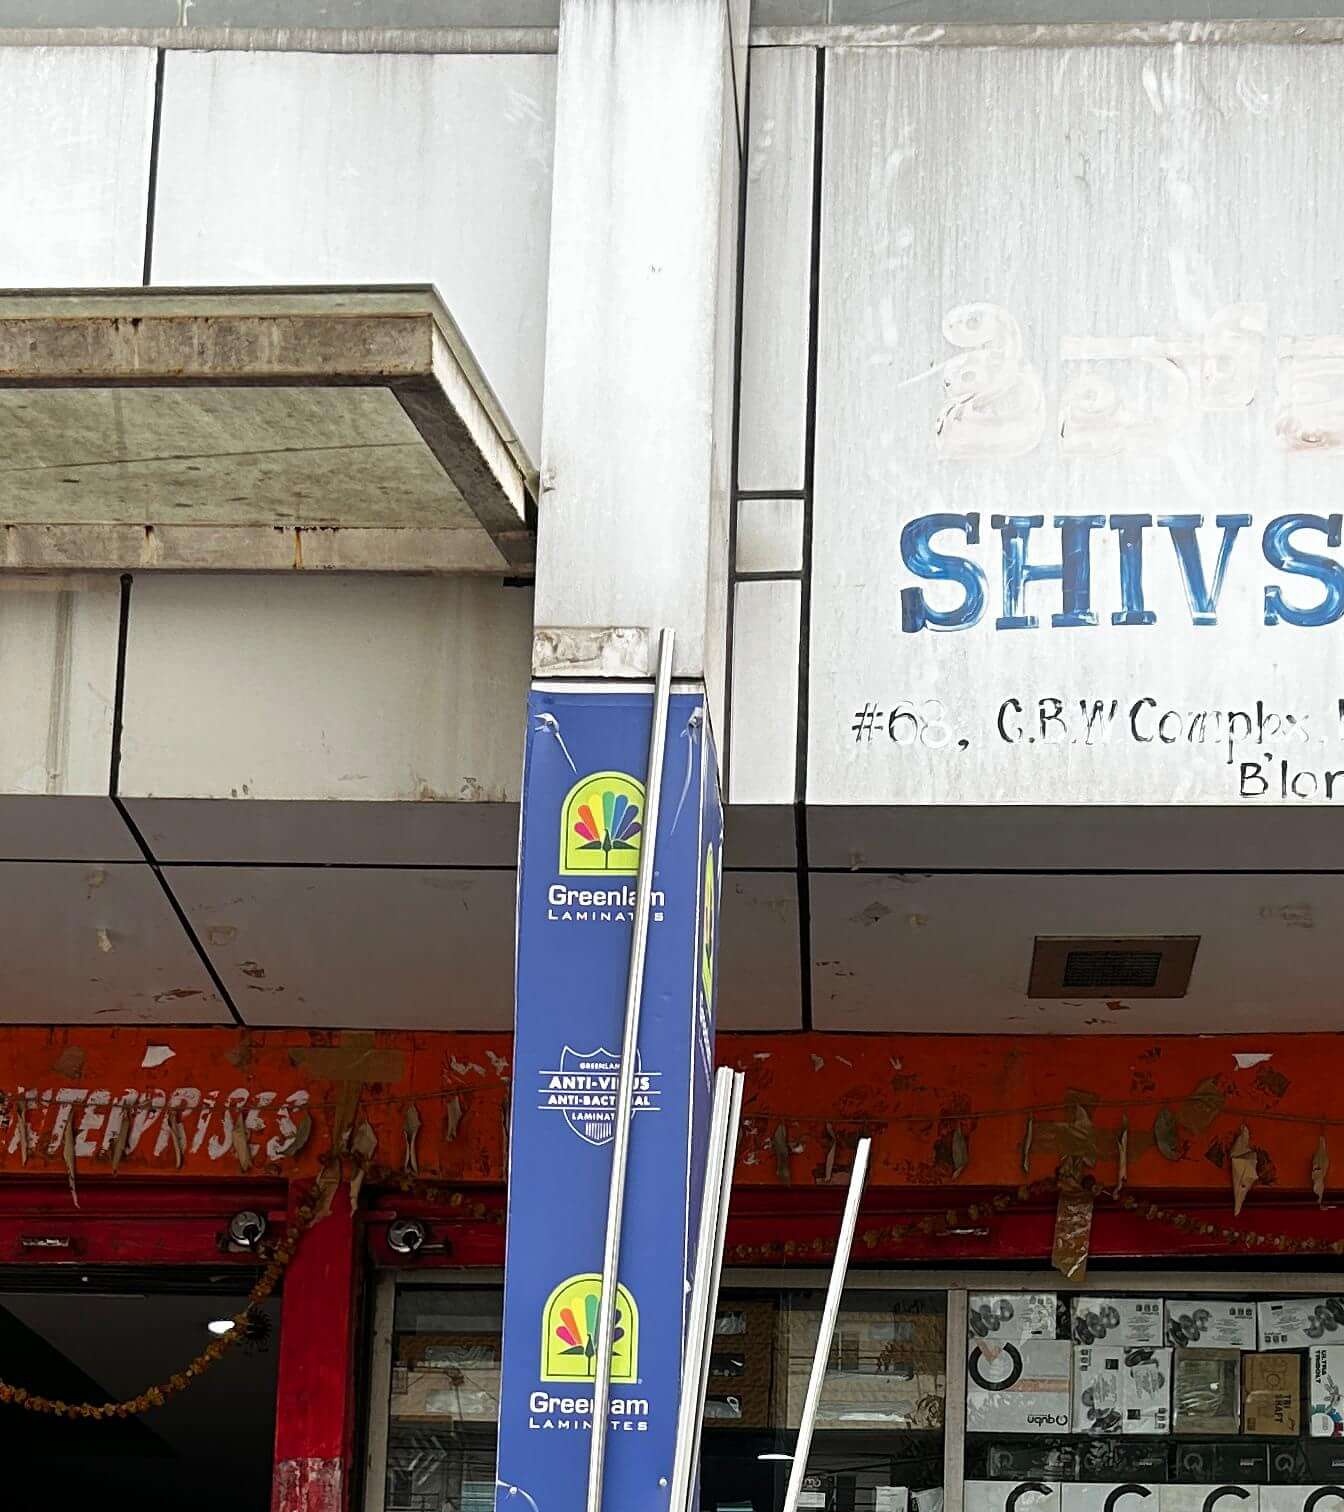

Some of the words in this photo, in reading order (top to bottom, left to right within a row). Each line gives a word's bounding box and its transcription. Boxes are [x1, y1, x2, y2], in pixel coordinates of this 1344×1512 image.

[548, 909, 664, 922] LAMINATS
[549, 1075, 651, 1090] ANTI-VIUS
[548, 1094, 651, 1106] ANTI-BACTAL
[529, 1391, 649, 1415] Greenam
[528, 1418, 648, 1431] LAMINTES
